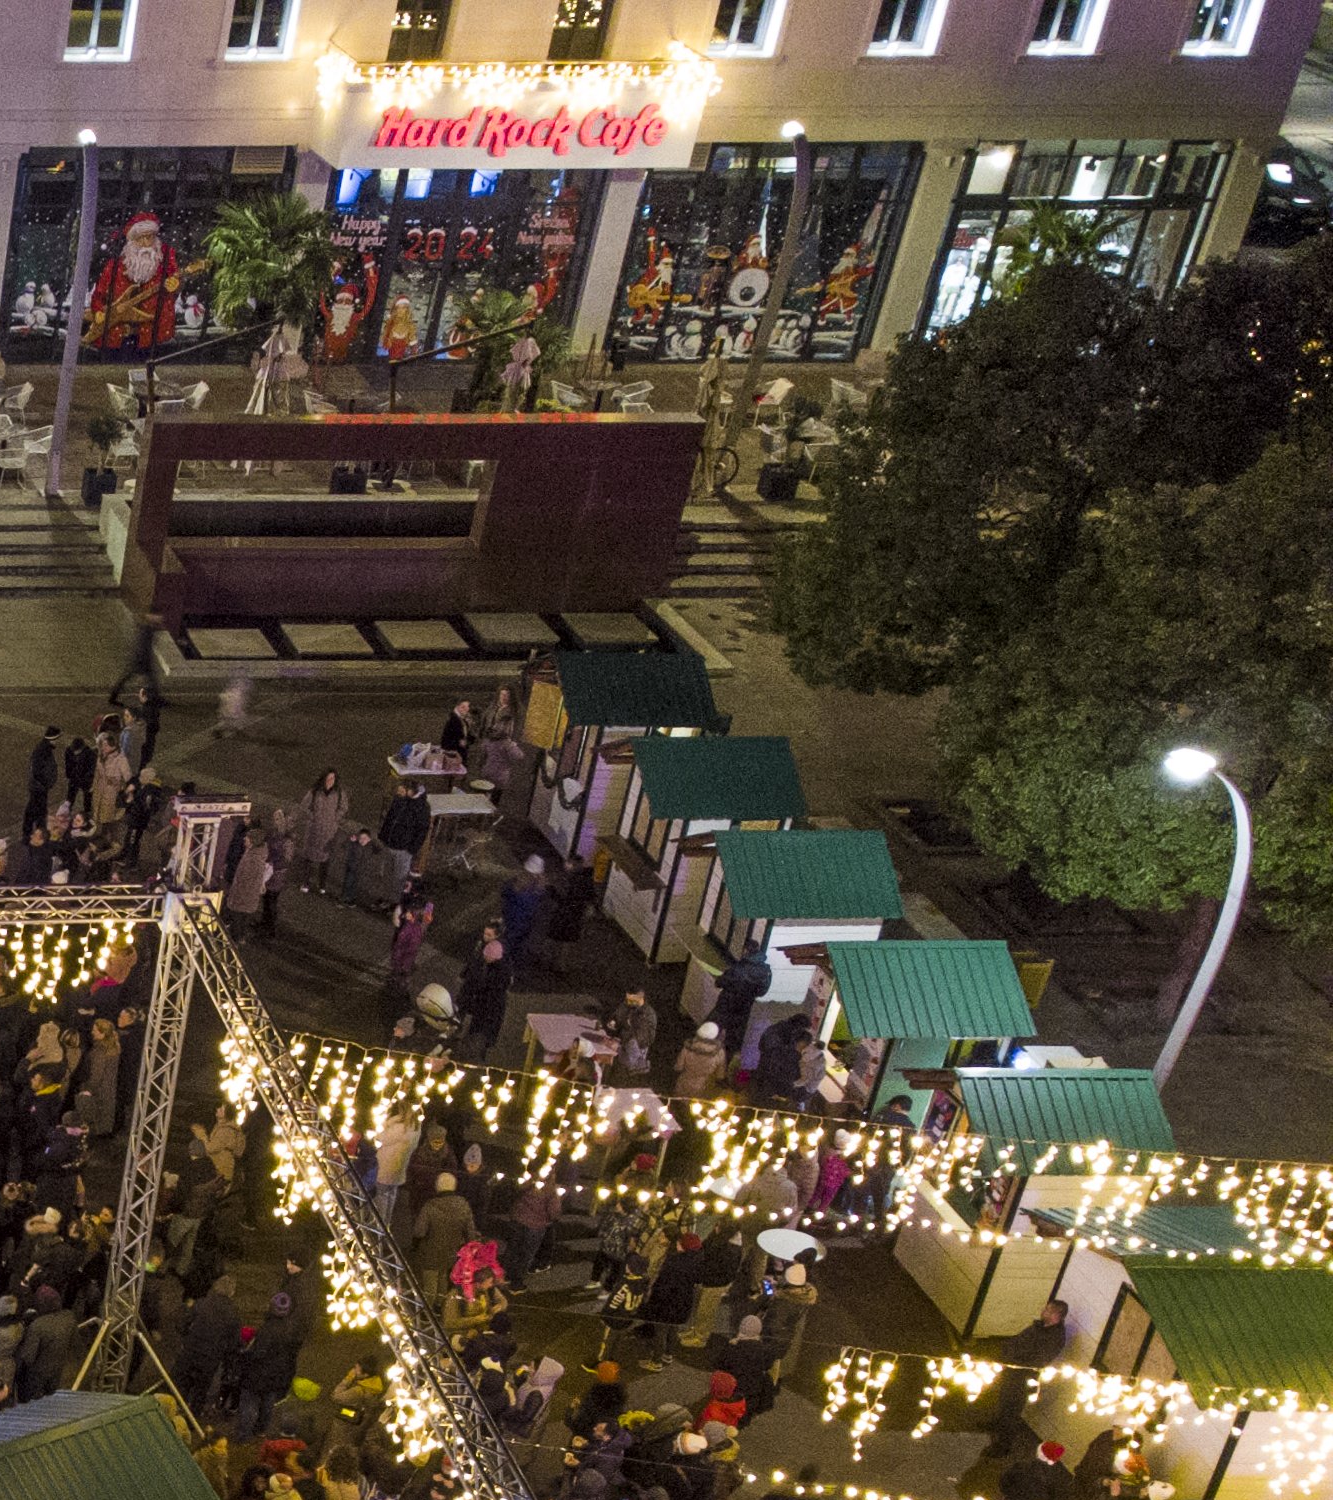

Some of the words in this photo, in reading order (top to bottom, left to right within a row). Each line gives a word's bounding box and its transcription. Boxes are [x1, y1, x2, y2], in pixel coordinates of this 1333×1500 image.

[375, 105, 483, 148] Hard
[479, 105, 575, 157] Rock
[579, 103, 669, 155] Cafe
[341, 214, 381, 236] Happy
[329, 231, 357, 247] New
